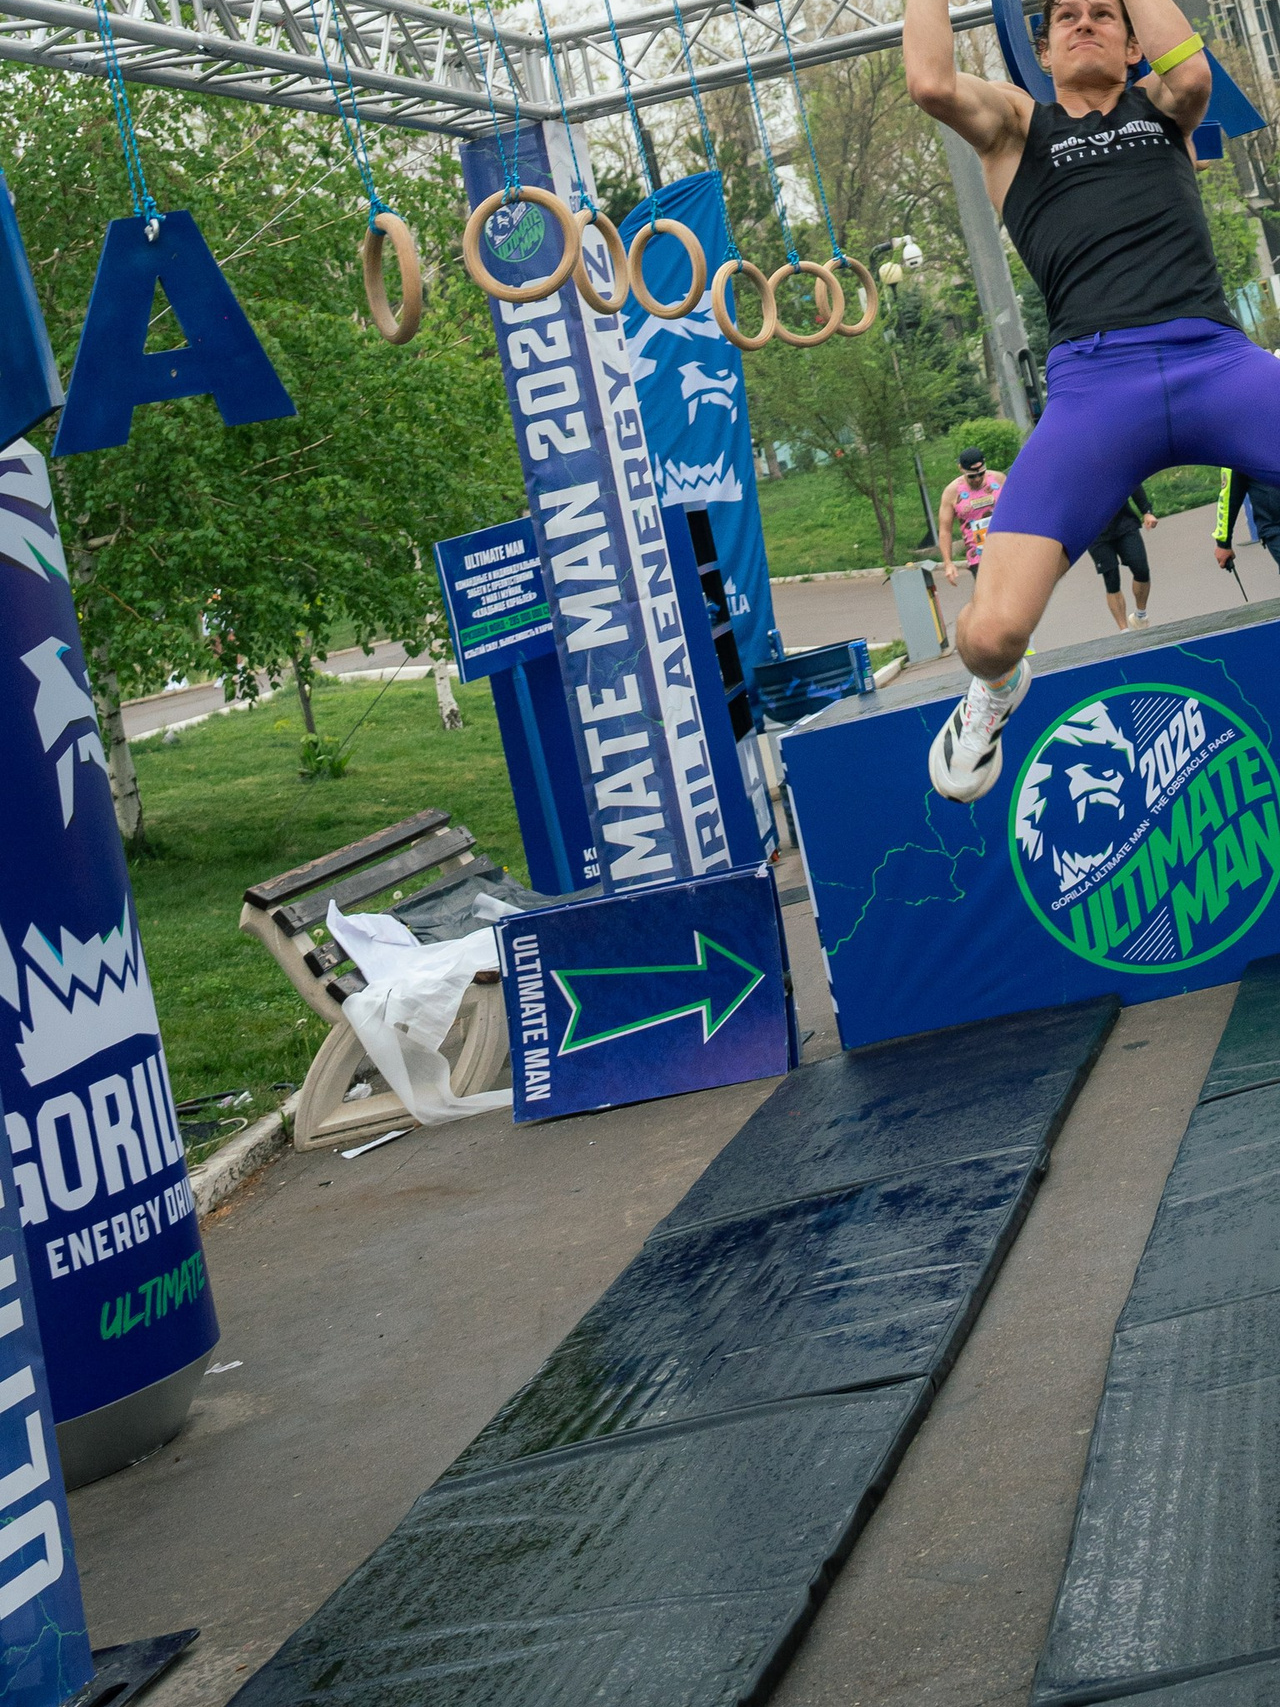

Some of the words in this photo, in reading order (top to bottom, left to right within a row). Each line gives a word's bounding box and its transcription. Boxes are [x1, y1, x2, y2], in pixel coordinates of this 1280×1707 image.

[499, 275, 590, 461] 2026
[464, 545, 505, 570] ULTIMATE
[505, 539, 525, 558] MAN
[537, 477, 629, 653] MAN
[1139, 696, 1207, 808] 2026
[1051, 880, 1093, 911] GORILLA
[1093, 841, 1131, 884] ULTIMATE
[1150, 794, 1170, 815] THE
[1166, 749, 1210, 796] OBSTACLE
[1207, 728, 1236, 757] RACE
[1069, 744, 1273, 958] ULTIMATE
[512, 934, 549, 1044] ULTIMATE
[523, 1047, 551, 1102] MAN
[46, 1196, 162, 1280] ENERGY
[100, 1249, 205, 1340] ULTIMATE
